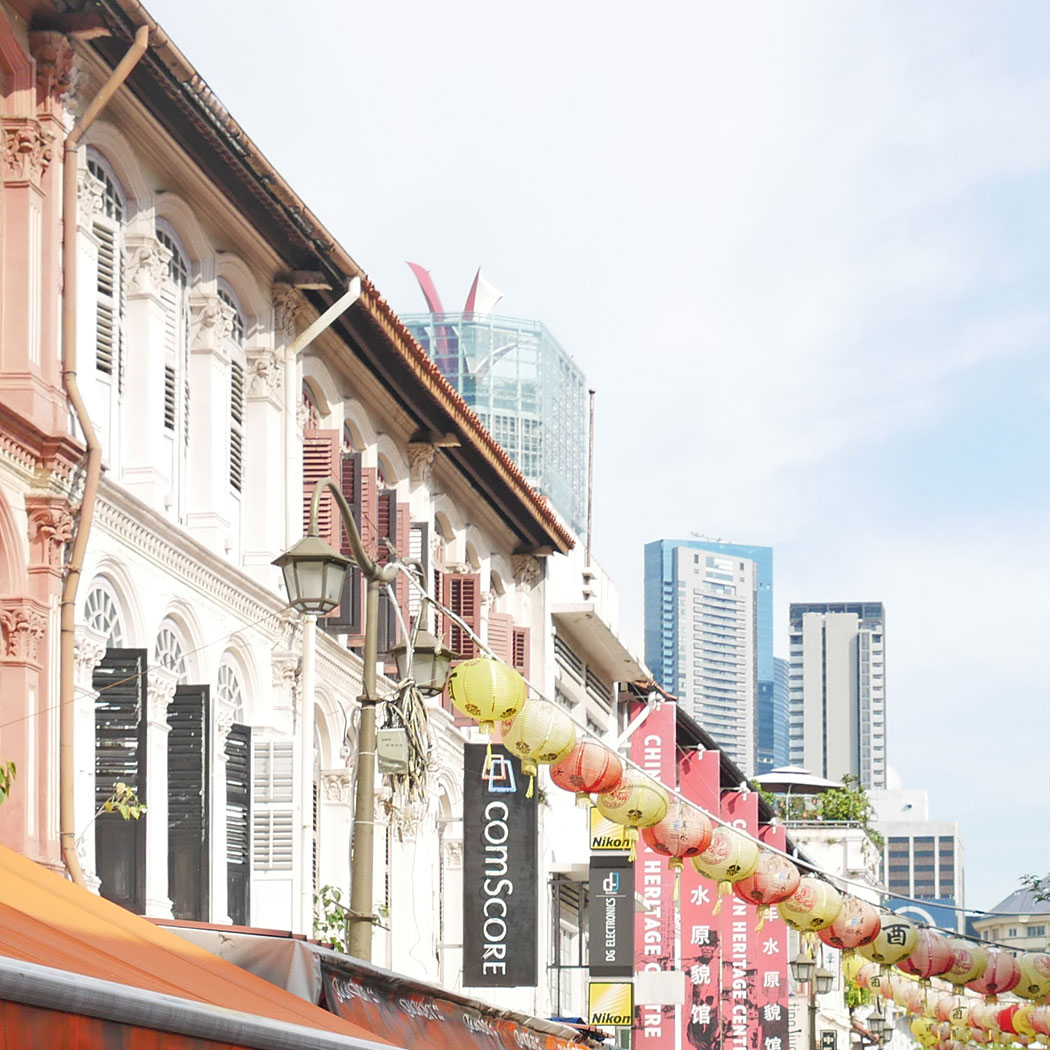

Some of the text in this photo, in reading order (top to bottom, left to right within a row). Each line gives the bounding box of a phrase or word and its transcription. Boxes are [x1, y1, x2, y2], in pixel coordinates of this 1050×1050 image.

[592, 836, 631, 849] Nikon
[605, 897, 616, 962] DG ELECTRONICS
[644, 860, 662, 956] HERITAGE
[732, 921, 748, 1001] HERITAGE
[592, 1012, 632, 1024] Nikon
